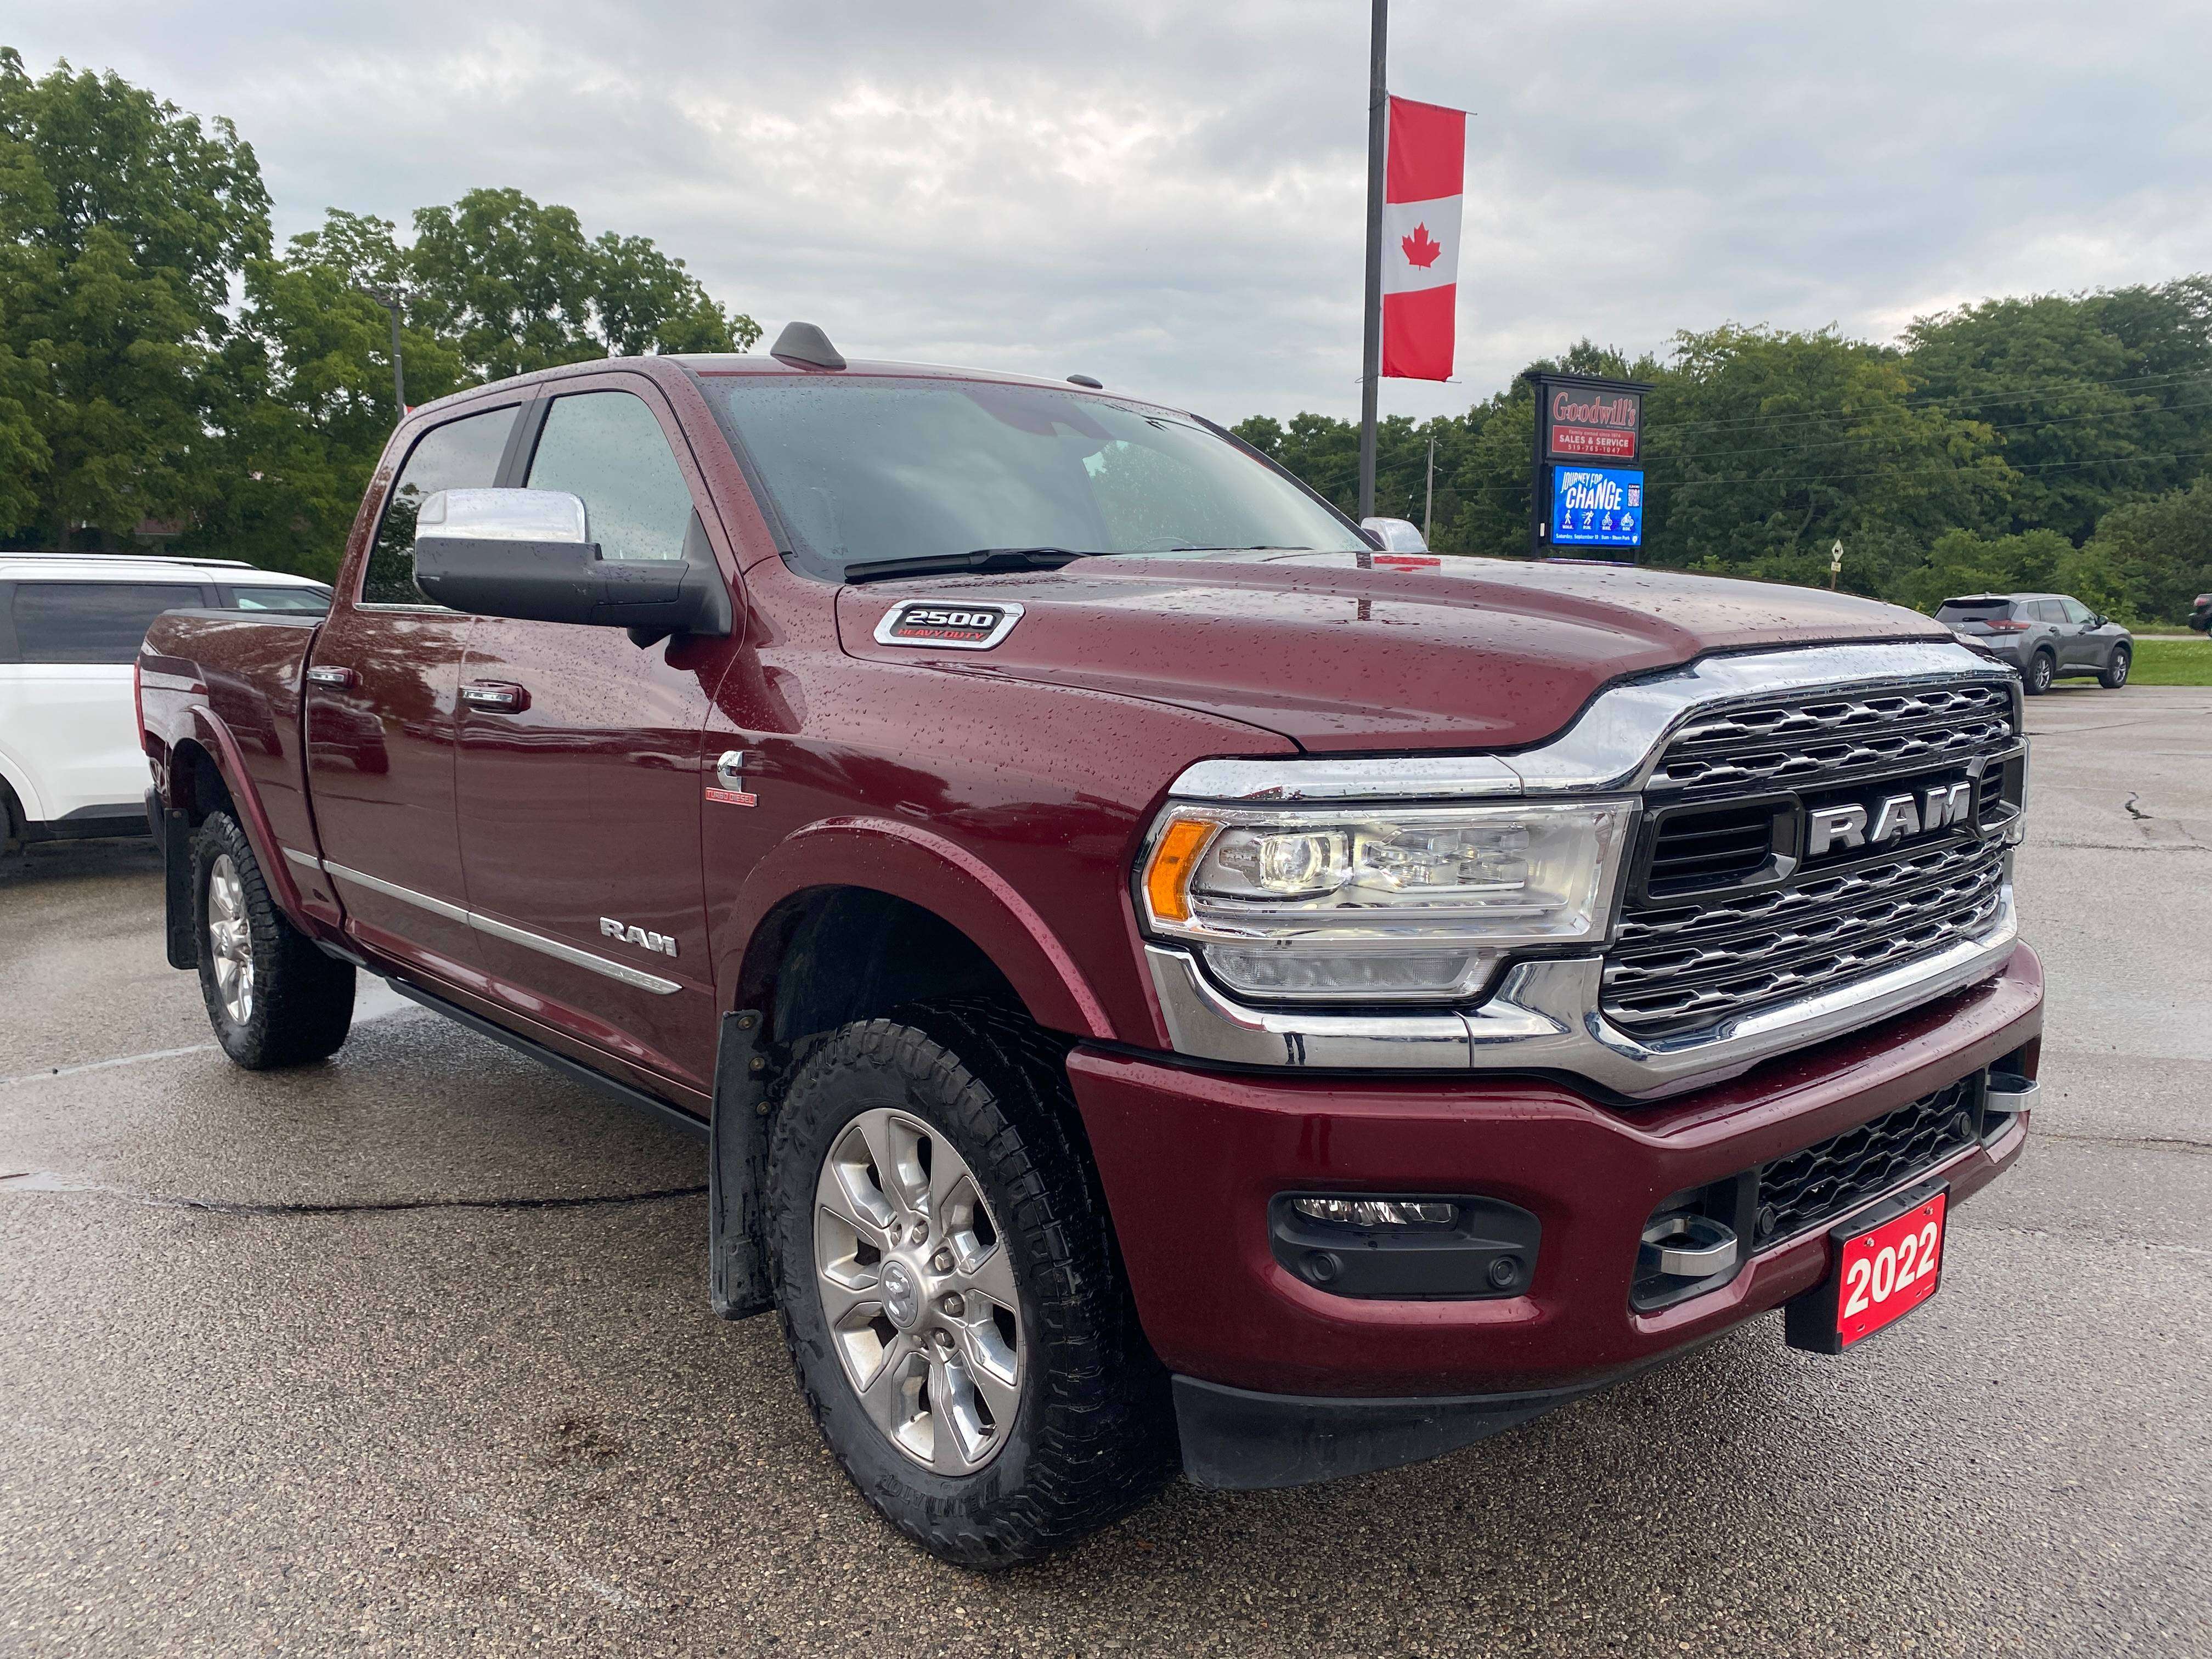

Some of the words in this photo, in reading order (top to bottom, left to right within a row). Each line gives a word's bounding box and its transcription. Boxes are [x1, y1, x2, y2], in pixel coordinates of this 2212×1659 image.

[1553, 392, 1636, 426] Goodwill's
[1559, 435, 1585, 444] SALES
[1596, 438, 1629, 448] SERVICE
[1568, 444, 1620, 453] 519-765-1047
[1560, 472, 1590, 494] JOURNEY
[1589, 473, 1603, 488] FOR
[1566, 478, 1623, 511] CHANGE
[905, 610, 995, 629] 2500
[898, 628, 945, 637] HEAVY
[944, 631, 984, 640] DUTY
[706, 789, 729, 799] TURBO
[729, 793, 754, 804] DIESEL
[1809, 781, 1971, 855] RAM
[600, 917, 678, 957] RAM
[1843, 1221, 1938, 1319] 2022
